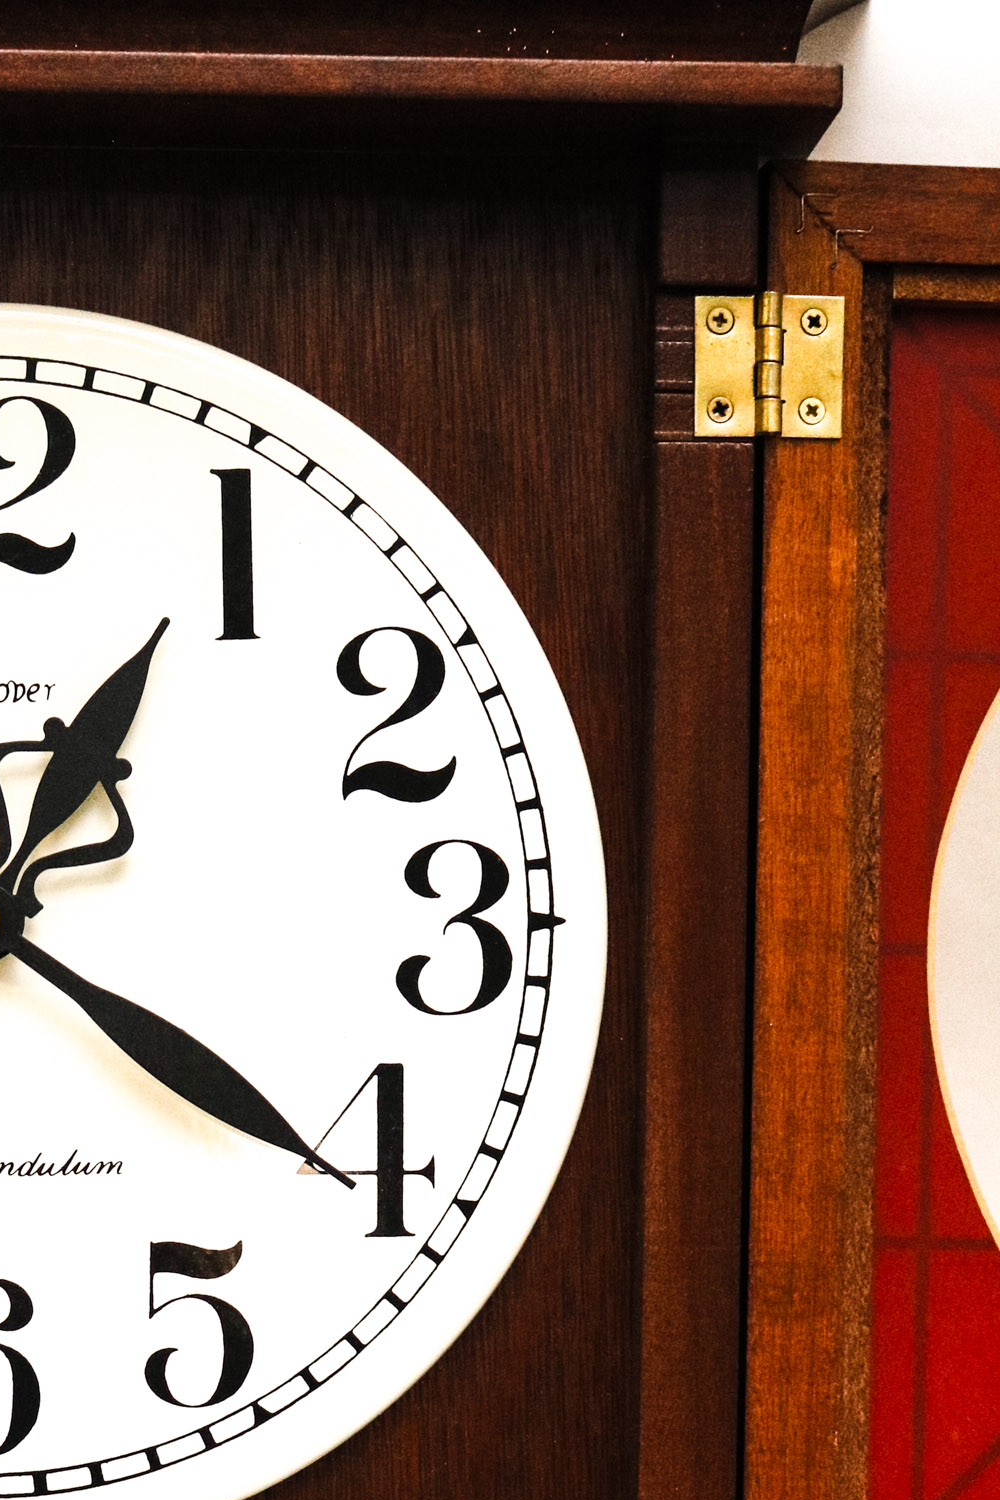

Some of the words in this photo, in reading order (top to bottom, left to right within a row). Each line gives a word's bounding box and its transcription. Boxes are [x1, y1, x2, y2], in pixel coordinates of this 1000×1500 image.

[210, 469, 260, 640] 1
[337, 627, 456, 802] 2
[396, 840, 512, 1015] 3
[297, 1063, 435, 1237] 4
[145, 1241, 254, 1408] 5
